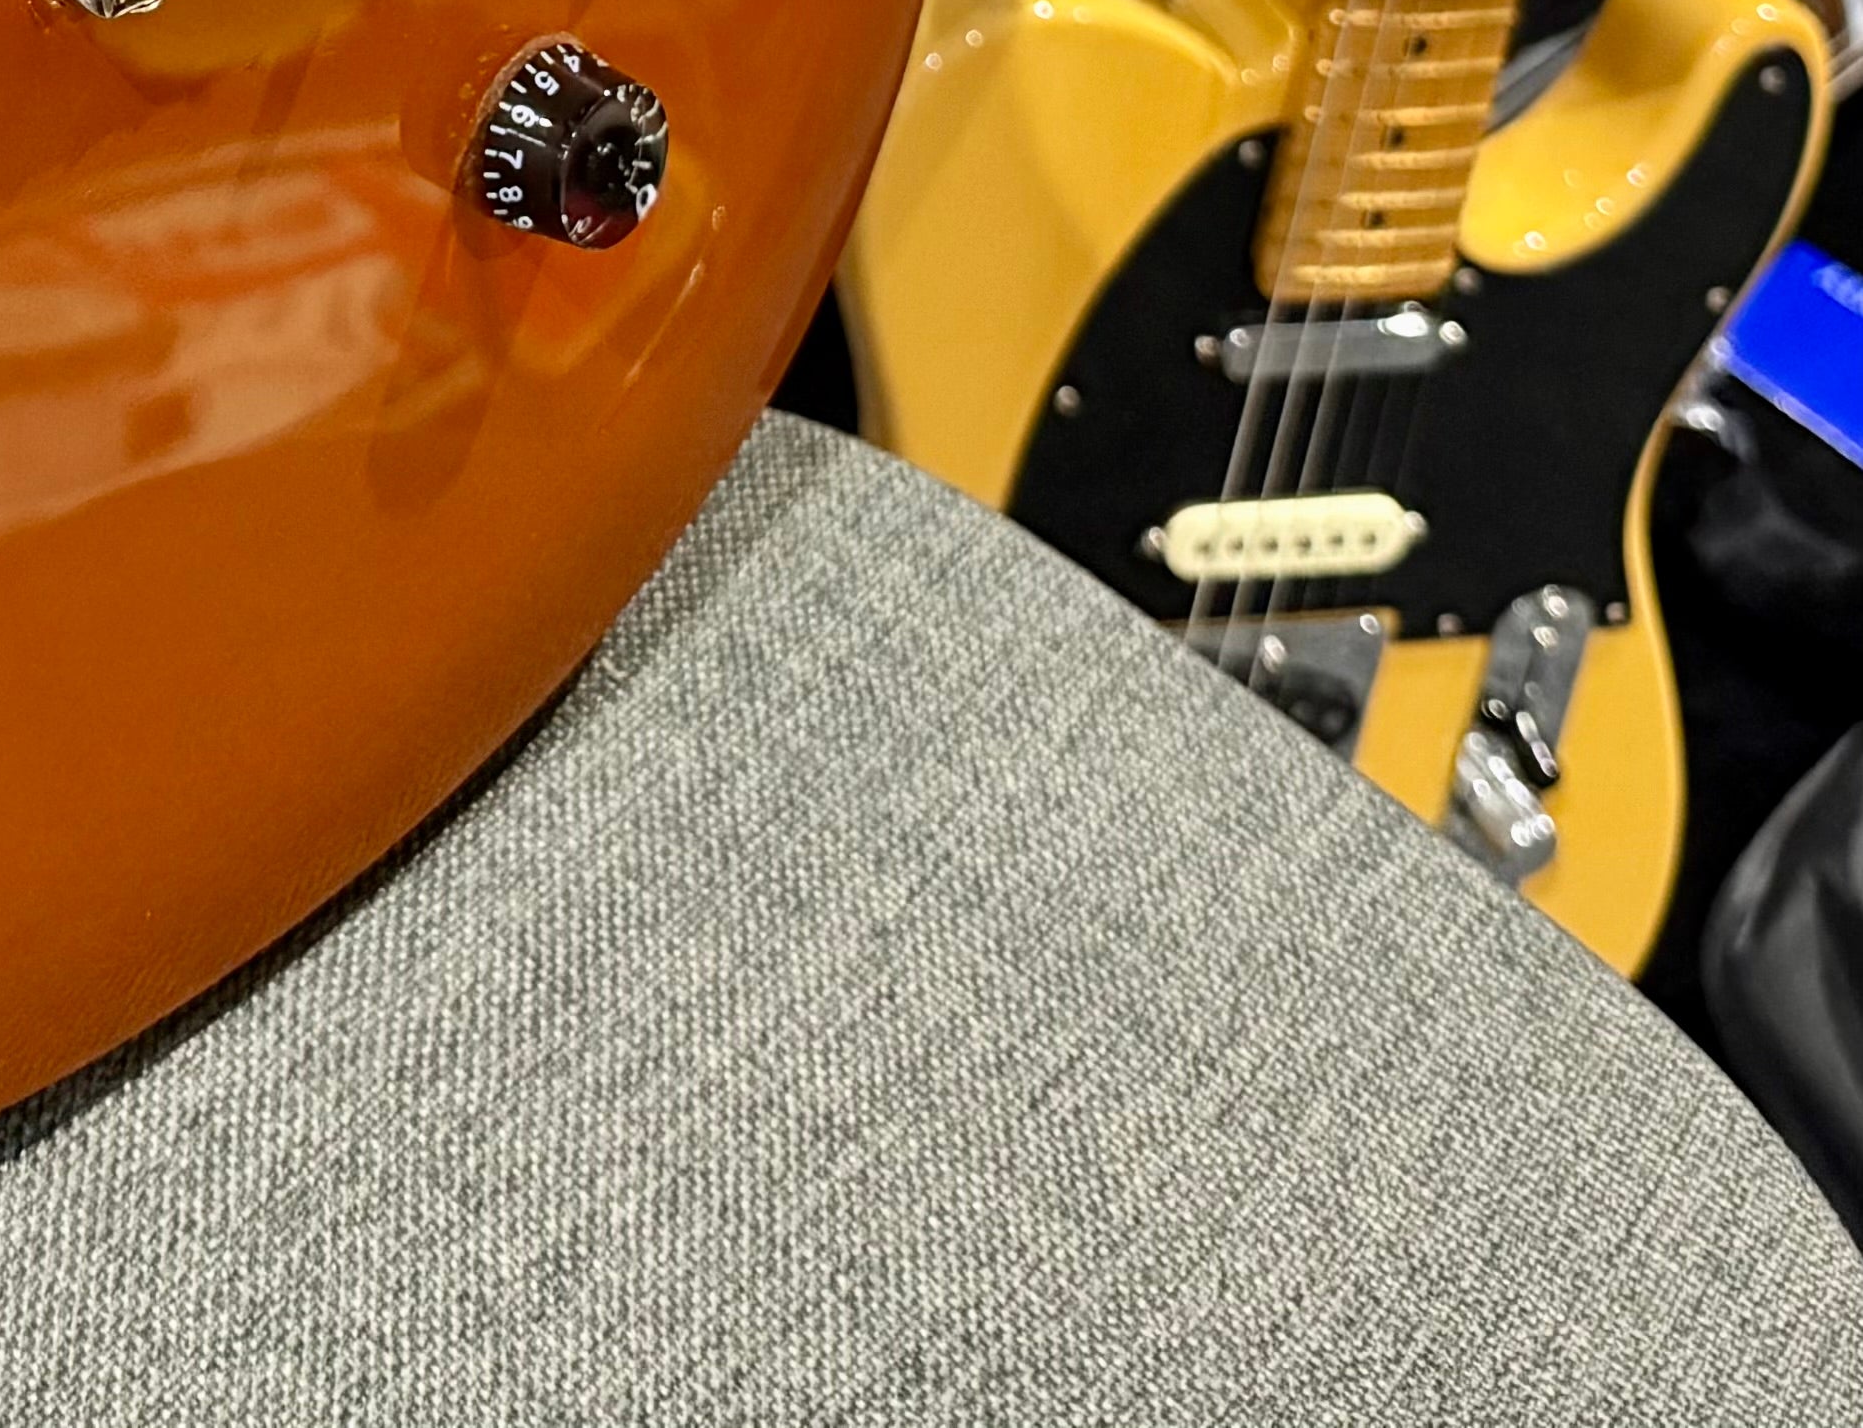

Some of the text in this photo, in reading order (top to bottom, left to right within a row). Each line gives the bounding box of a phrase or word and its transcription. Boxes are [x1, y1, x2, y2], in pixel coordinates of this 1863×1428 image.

[563, 54, 581, 73] 4
[534, 71, 560, 96] 5
[511, 104, 539, 128] 6
[498, 149, 524, 170] 7
[498, 185, 524, 203] 8
